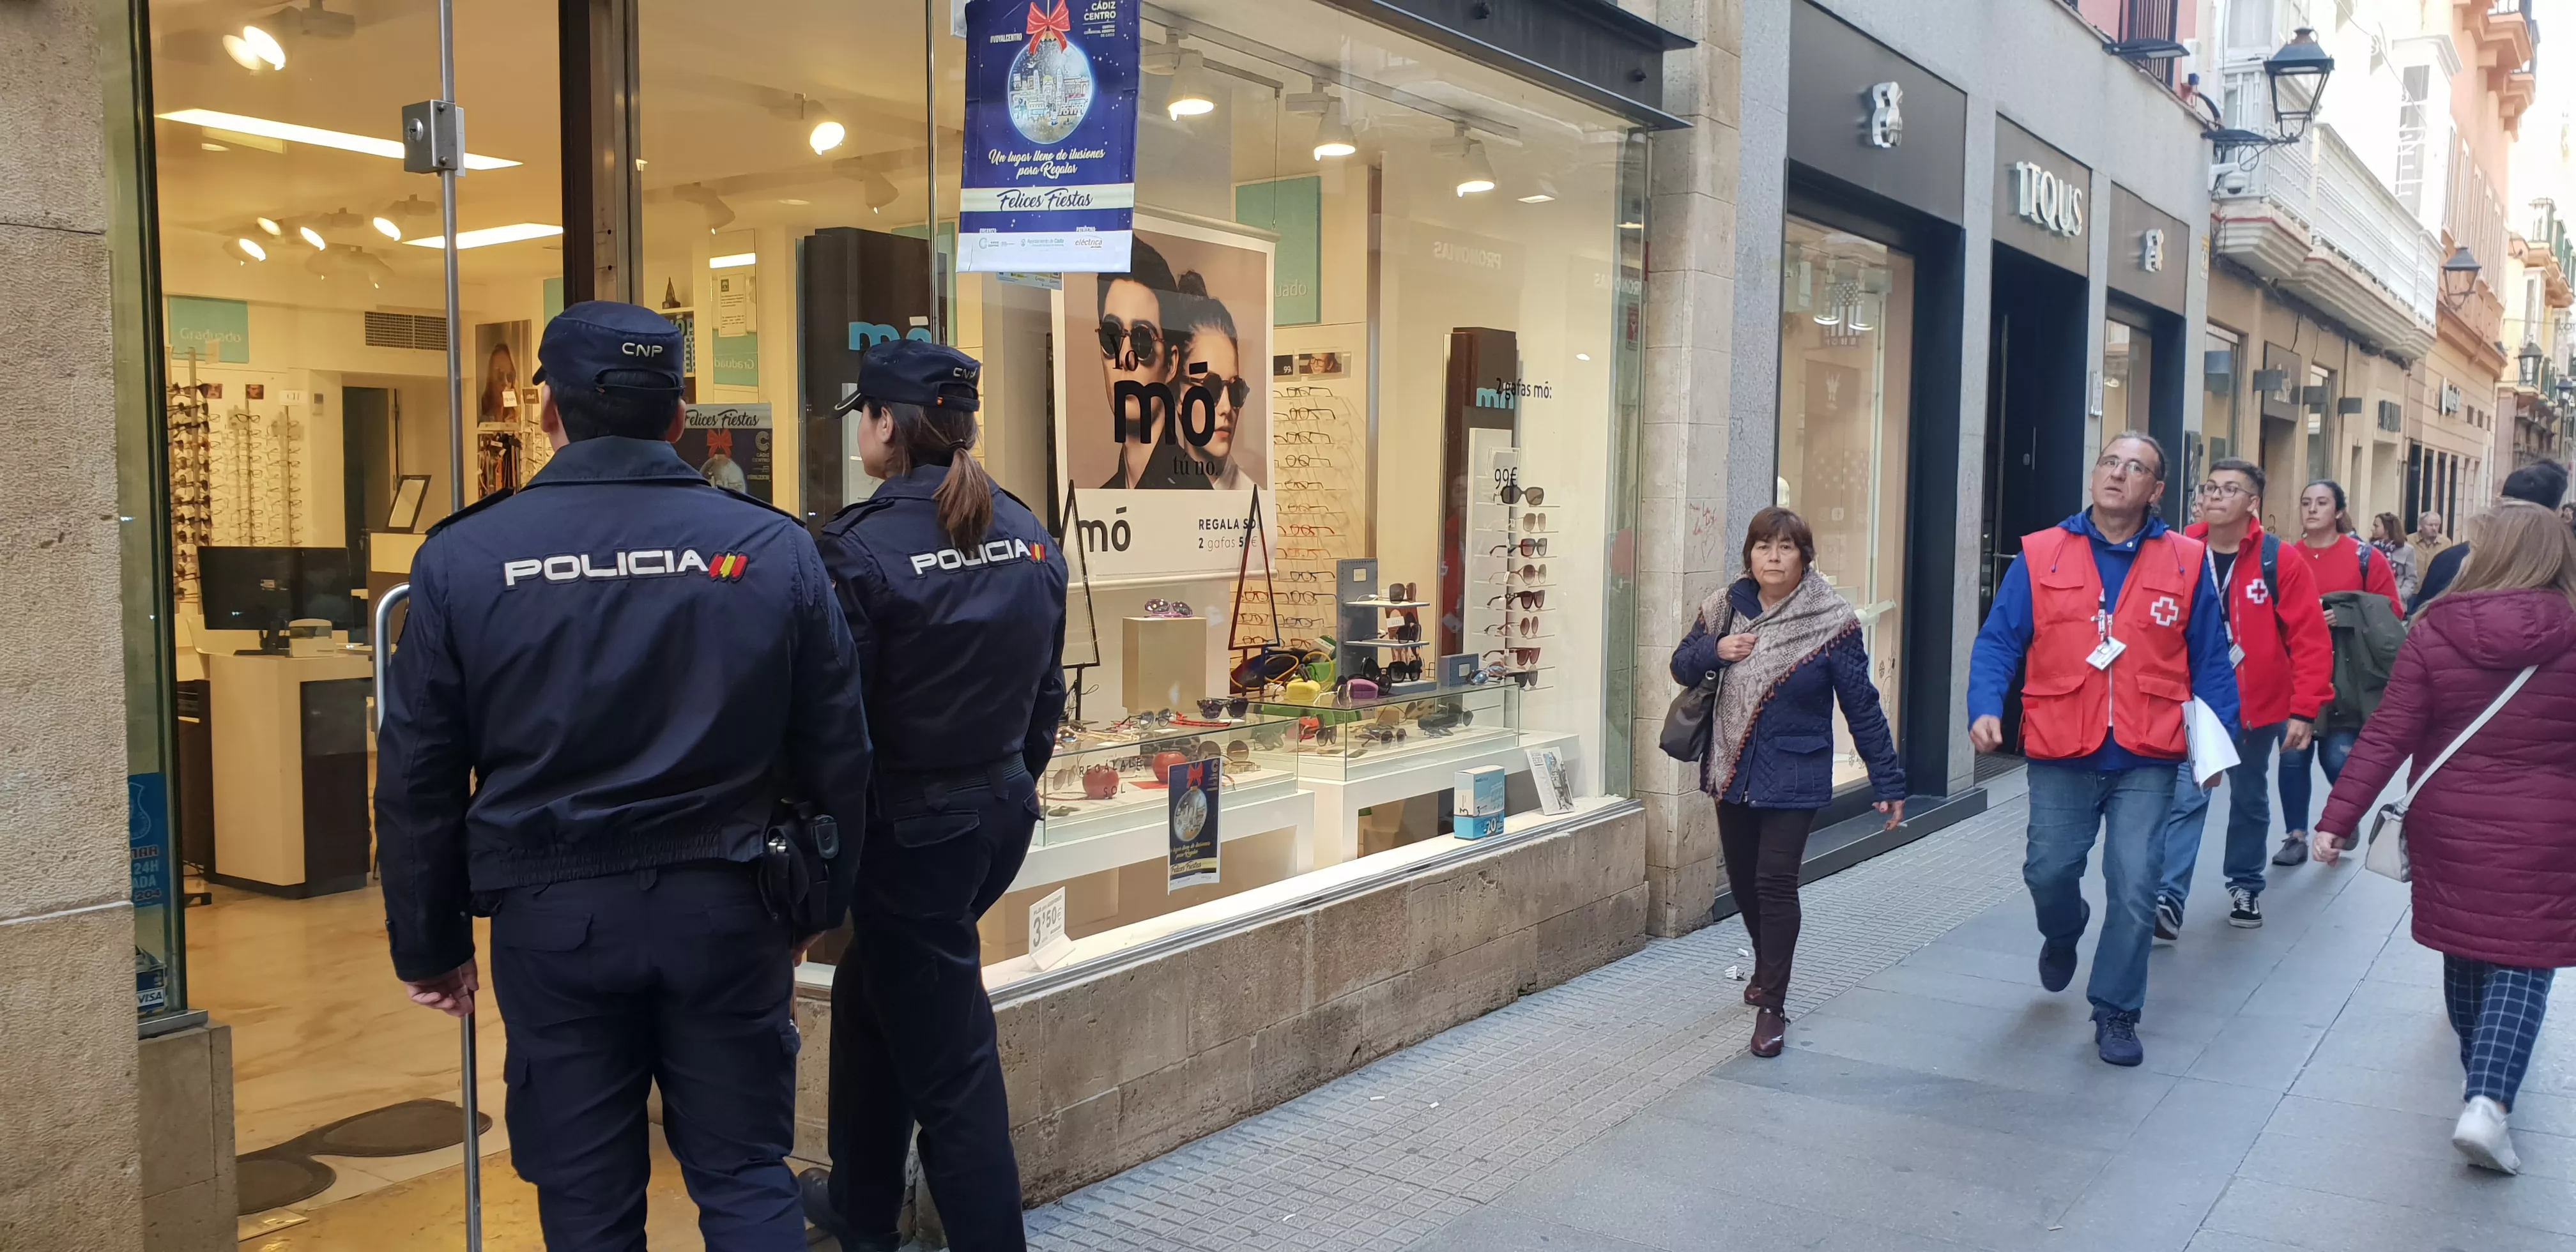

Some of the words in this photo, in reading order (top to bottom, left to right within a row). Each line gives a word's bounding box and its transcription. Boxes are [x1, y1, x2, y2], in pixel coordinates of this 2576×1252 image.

[1084, 11, 1116, 20] CENTRO
[1091, 1, 1116, 11] CÁDIZ
[988, 149, 1006, 165] Un
[1008, 151, 1032, 167] lugar
[1032, 149, 1054, 162] lleno
[1056, 149, 1068, 160] de
[1068, 148, 1105, 159] ilusiones
[1016, 164, 1040, 179] para
[1040, 161, 1078, 179] Regalar
[997, 189, 1045, 211] Felices
[1044, 188, 1093, 211] Fiestas
[2018, 161, 2083, 236] TOUS
[622, 342, 663, 358] CNP
[1108, 333, 1139, 371] Yo
[953, 367, 978, 379] CNP
[1496, 378, 1502, 395] 2
[1505, 378, 1531, 401] gafas
[1114, 362, 1216, 447] mó
[718, 409, 760, 429] Fiestas
[1173, 451, 1190, 477] tú
[1494, 467, 1518, 490] 99€
[1080, 507, 1131, 552] mó
[1199, 518, 1239, 530] REGALA
[1199, 537, 1204, 549] 2
[1208, 537, 1235, 551] gafas
[1239, 536, 1258, 547] 5€
[910, 538, 1031, 575] POLICIA
[504, 549, 708, 586] POLICIA
[1103, 784, 1126, 796] SOL
[134, 860, 160, 875] 24H
[138, 991, 163, 1004] VISA
